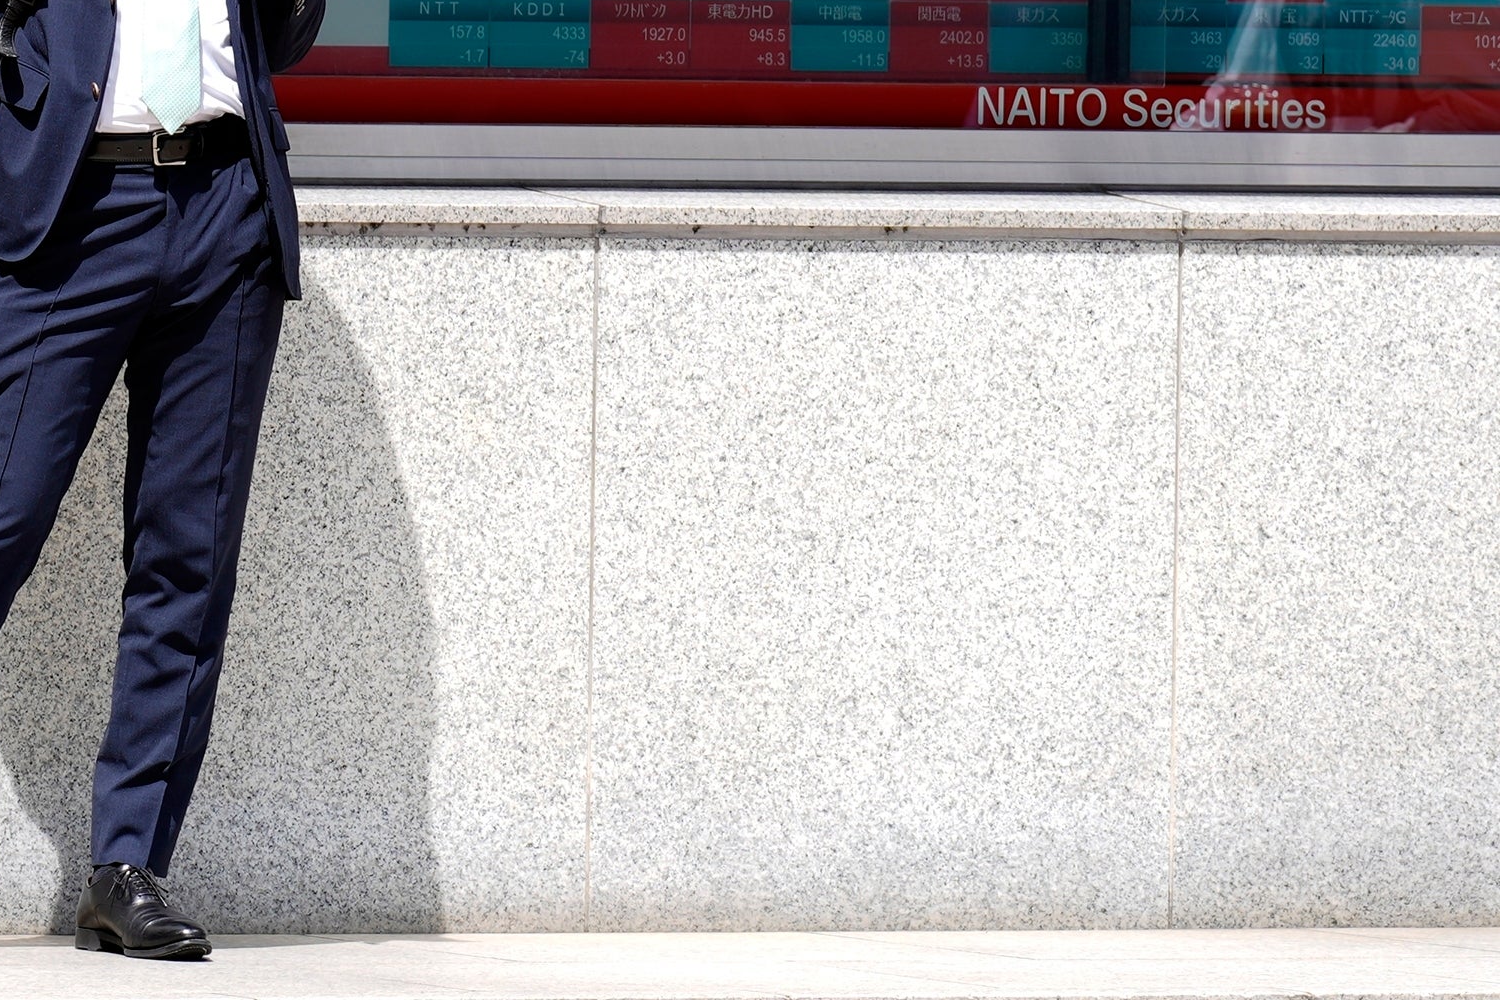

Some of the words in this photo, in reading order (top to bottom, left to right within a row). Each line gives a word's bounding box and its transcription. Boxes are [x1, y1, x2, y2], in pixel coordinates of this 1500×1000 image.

[708, 3, 774, 20] 東電力HD
[917, 5, 962, 22] 関西電
[749, 28, 786, 43] 945.5
[939, 30, 985, 45] 2402.0
[756, 51, 786, 66] +8.3
[947, 54, 984, 68] +13.5
[977, 86, 1107, 127] NAITO
[1122, 88, 1327, 129] Securities
